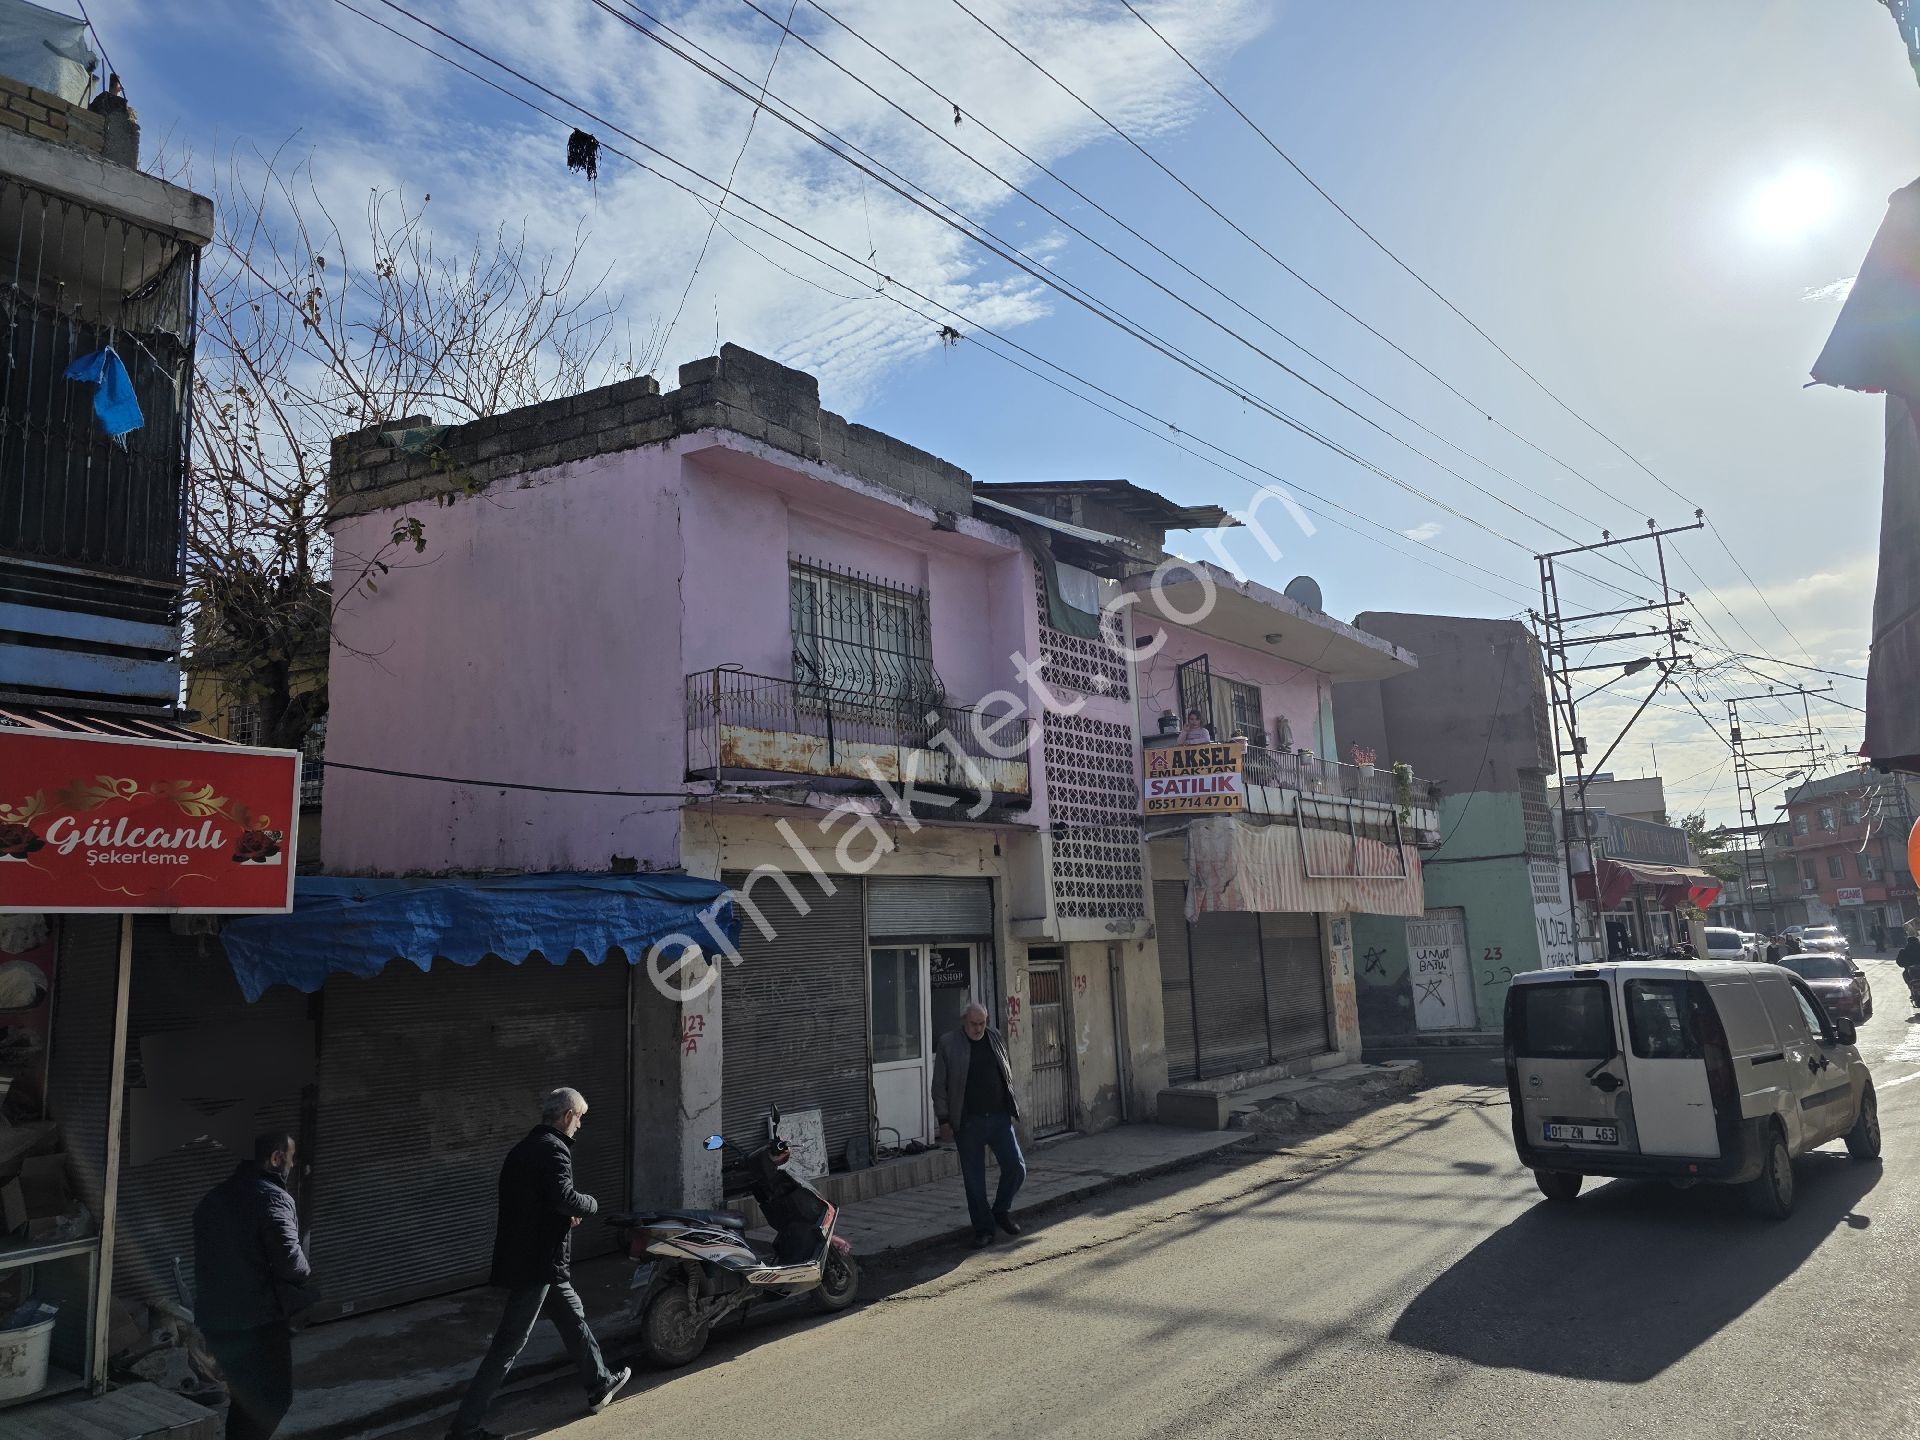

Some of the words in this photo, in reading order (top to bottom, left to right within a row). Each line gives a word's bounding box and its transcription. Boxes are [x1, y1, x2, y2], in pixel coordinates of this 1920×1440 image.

[1172, 746, 1237, 769] AKSEL
[1149, 765, 1236, 778] EMLAK'TAN
[1150, 775, 1236, 796] SATILIK
[1149, 798, 1176, 810] 0551
[1180, 797, 1201, 808] 714
[1205, 796, 1220, 807] 47
[1224, 795, 1239, 806] 01
[45, 815, 228, 856] Gülcanlı
[86, 849, 189, 867] Şekerleme
[1536, 916, 1580, 950] YILDIZLR
[1483, 947, 1503, 961] 23
[931, 972, 963, 982] ERSHOP
[1483, 966, 1512, 986] 23
[683, 1014, 705, 1032] 127
[686, 1038, 697, 1057] A
[1551, 1126, 1562, 1138] 01
[1595, 1127, 1615, 1140] 463
